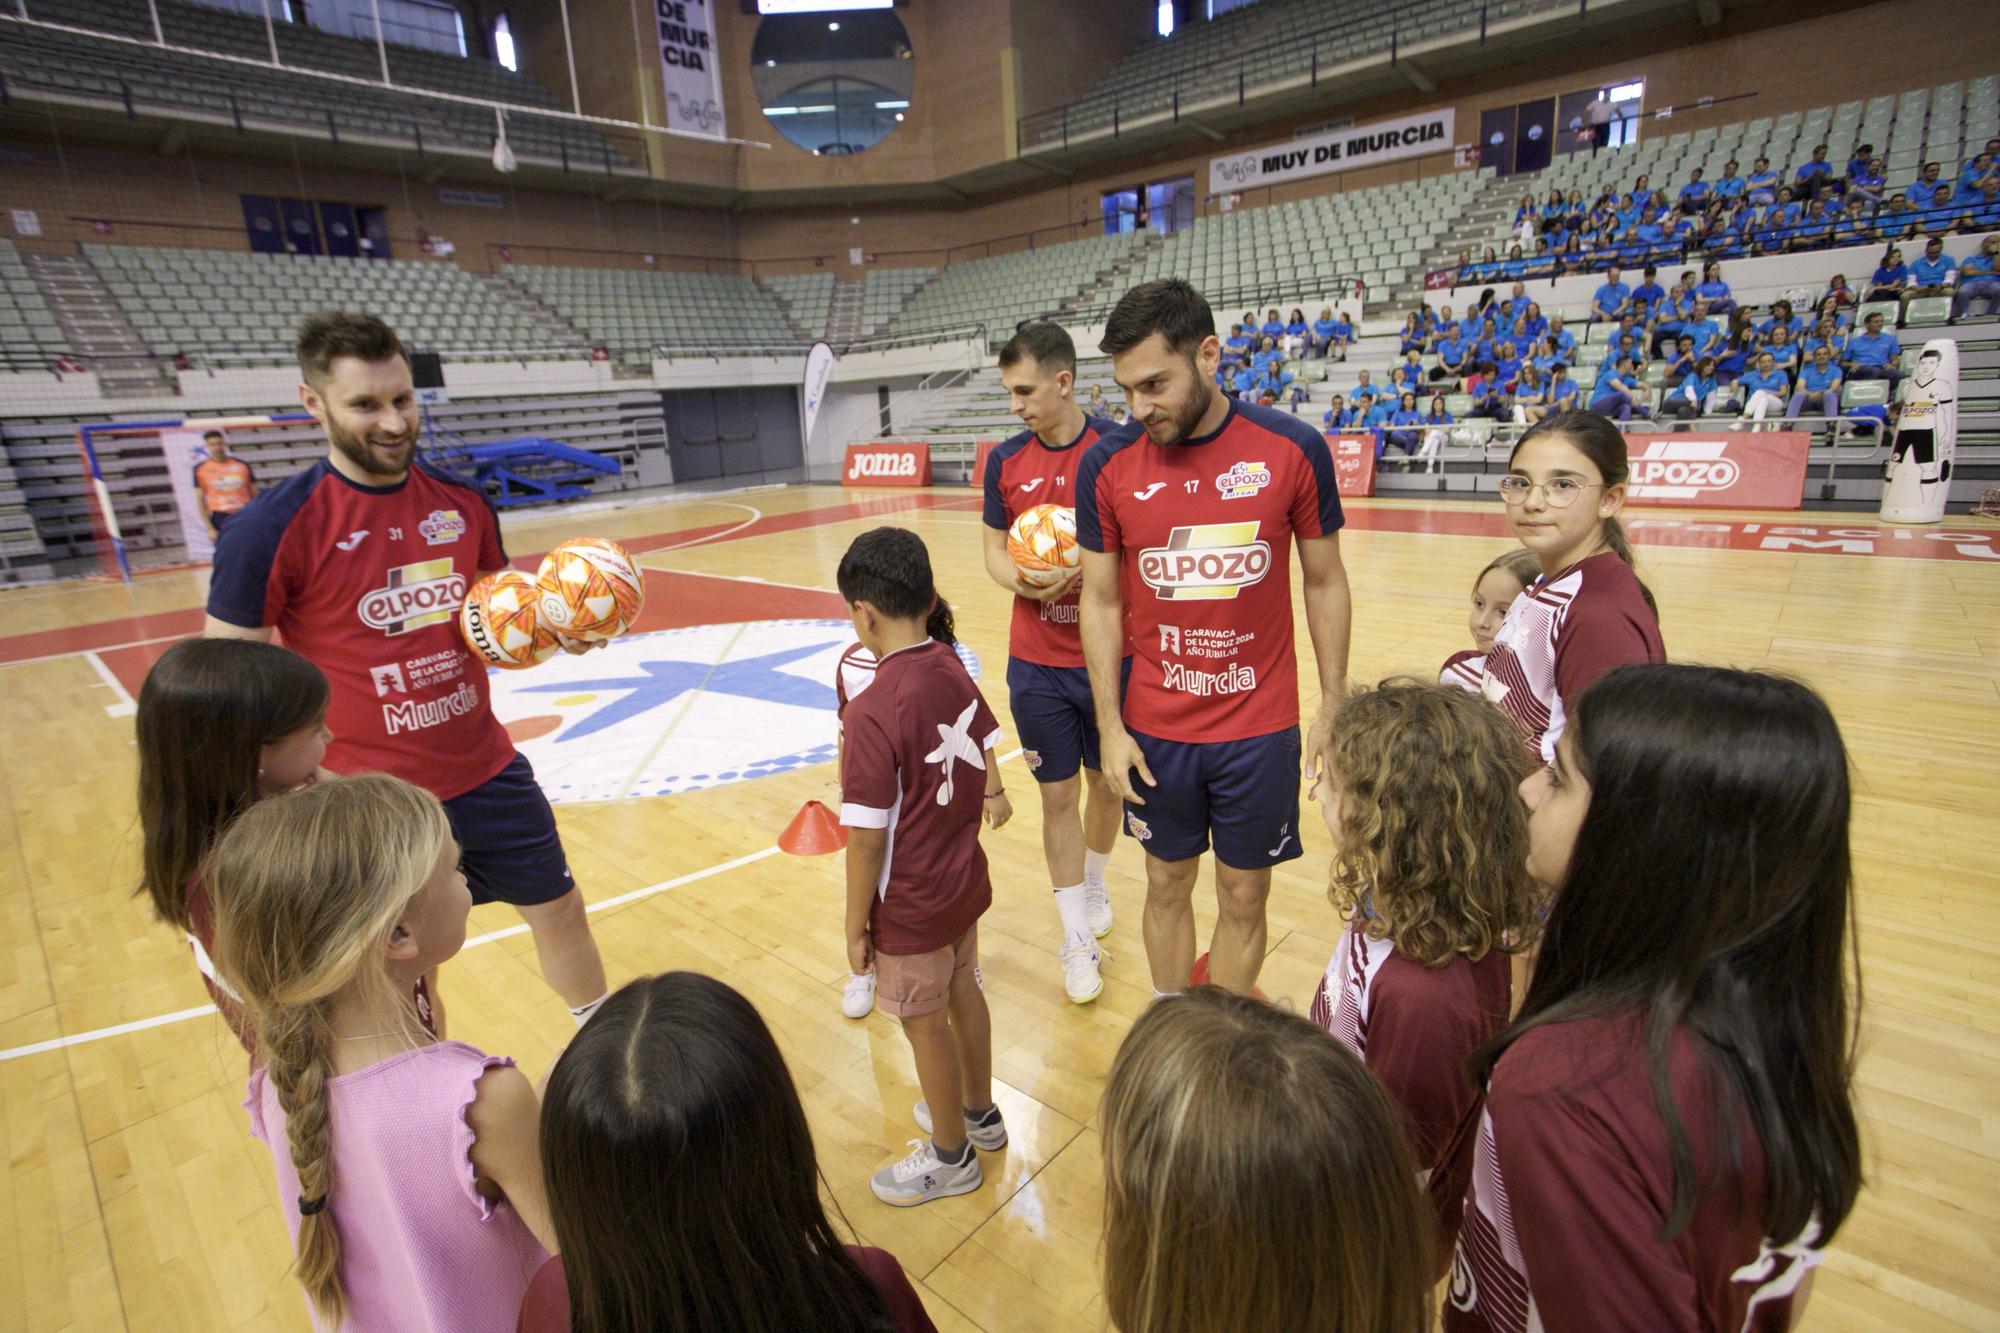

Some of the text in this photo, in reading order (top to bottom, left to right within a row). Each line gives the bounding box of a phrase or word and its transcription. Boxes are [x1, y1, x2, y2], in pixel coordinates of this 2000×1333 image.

[658, 0, 686, 22] DE
[663, 45, 704, 72] CIA
[1262, 150, 1309, 174] MUY
[1315, 143, 1341, 163] DE
[1347, 121, 1445, 157] MURCIA
[1055, 476, 1065, 486] 11
[1627, 461, 1734, 485] LPOZO
[1184, 480, 1200, 494] 17
[388, 527, 403, 540] 31
[1184, 628, 1236, 639] CARAVACA
[1185, 632, 1255, 649] DE LA CRUZ 2024
[1185, 646, 1238, 658] AÑO JUBILAR
[1161, 659, 1257, 696] Murcia
[382, 681, 479, 735] Murcia
